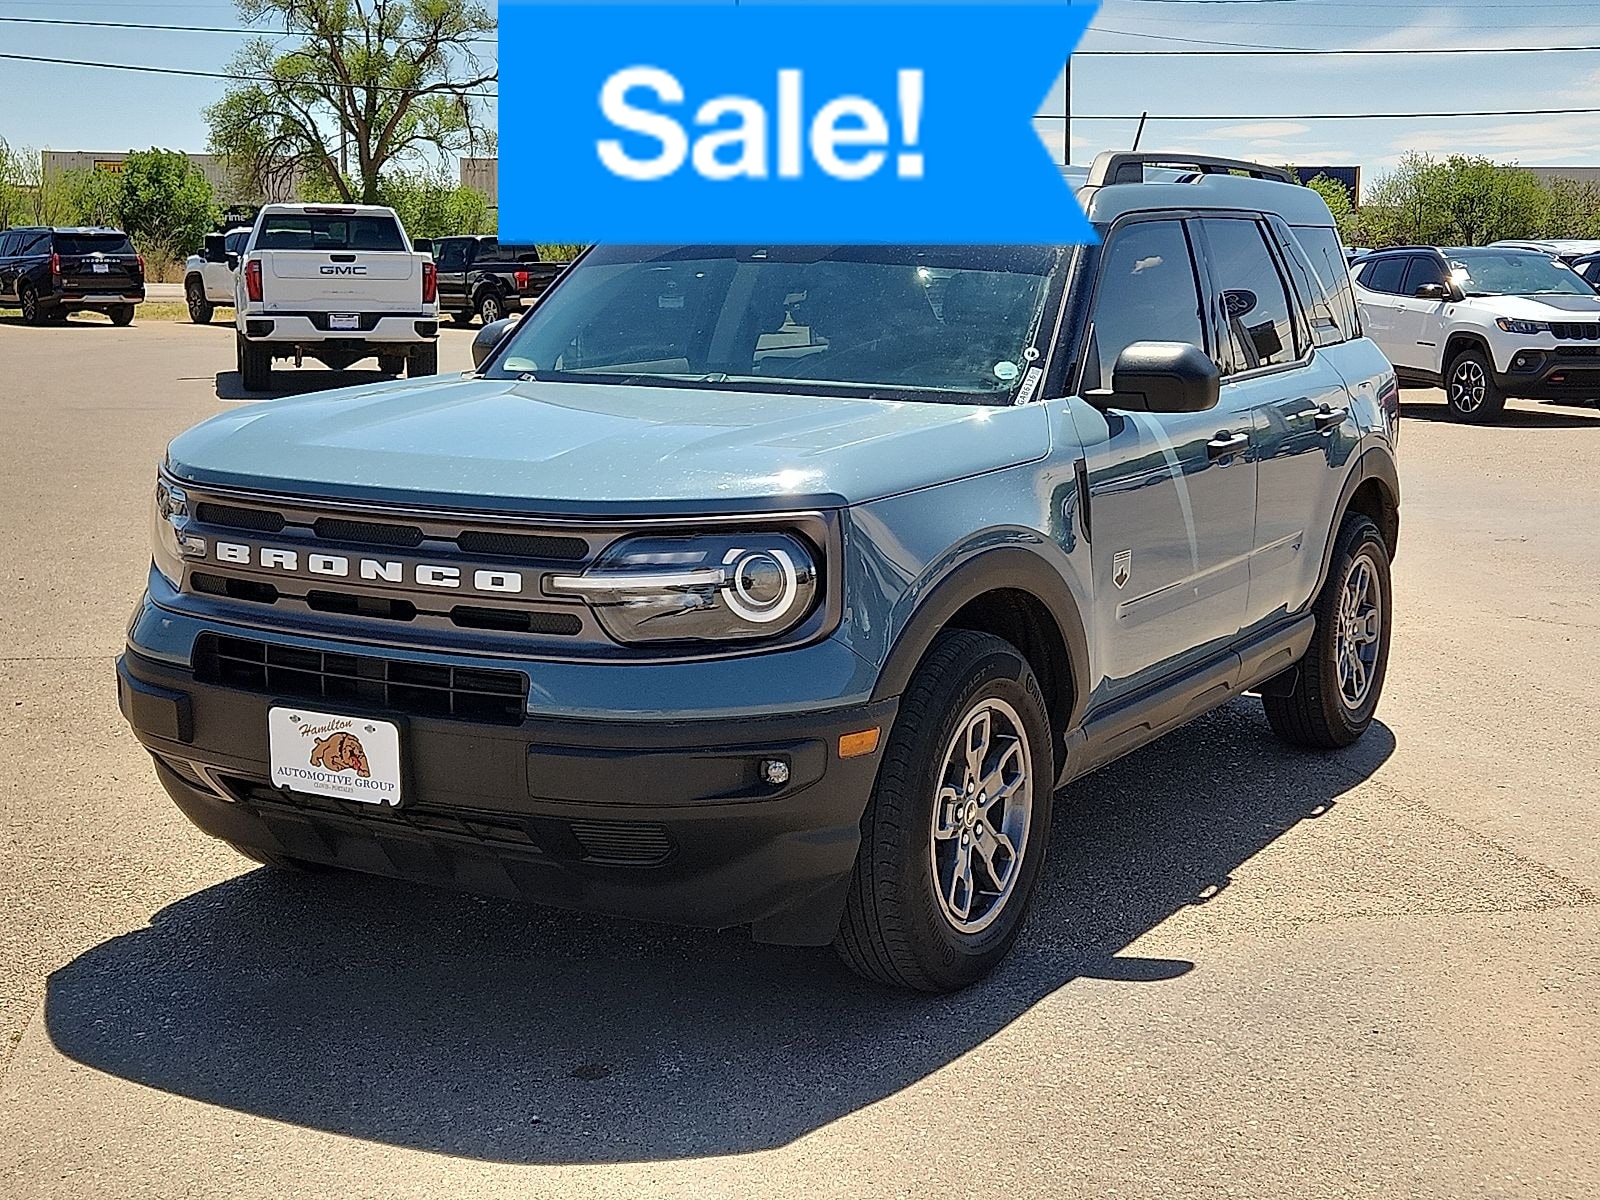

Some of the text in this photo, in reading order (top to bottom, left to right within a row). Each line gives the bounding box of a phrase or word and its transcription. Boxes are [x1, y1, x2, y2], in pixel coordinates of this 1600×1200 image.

[319, 266, 367, 275] GMC
[216, 541, 522, 594] BRONCO
[298, 719, 353, 737] Hamilton
[277, 766, 395, 792] AUTOMOTIVE GROUP
